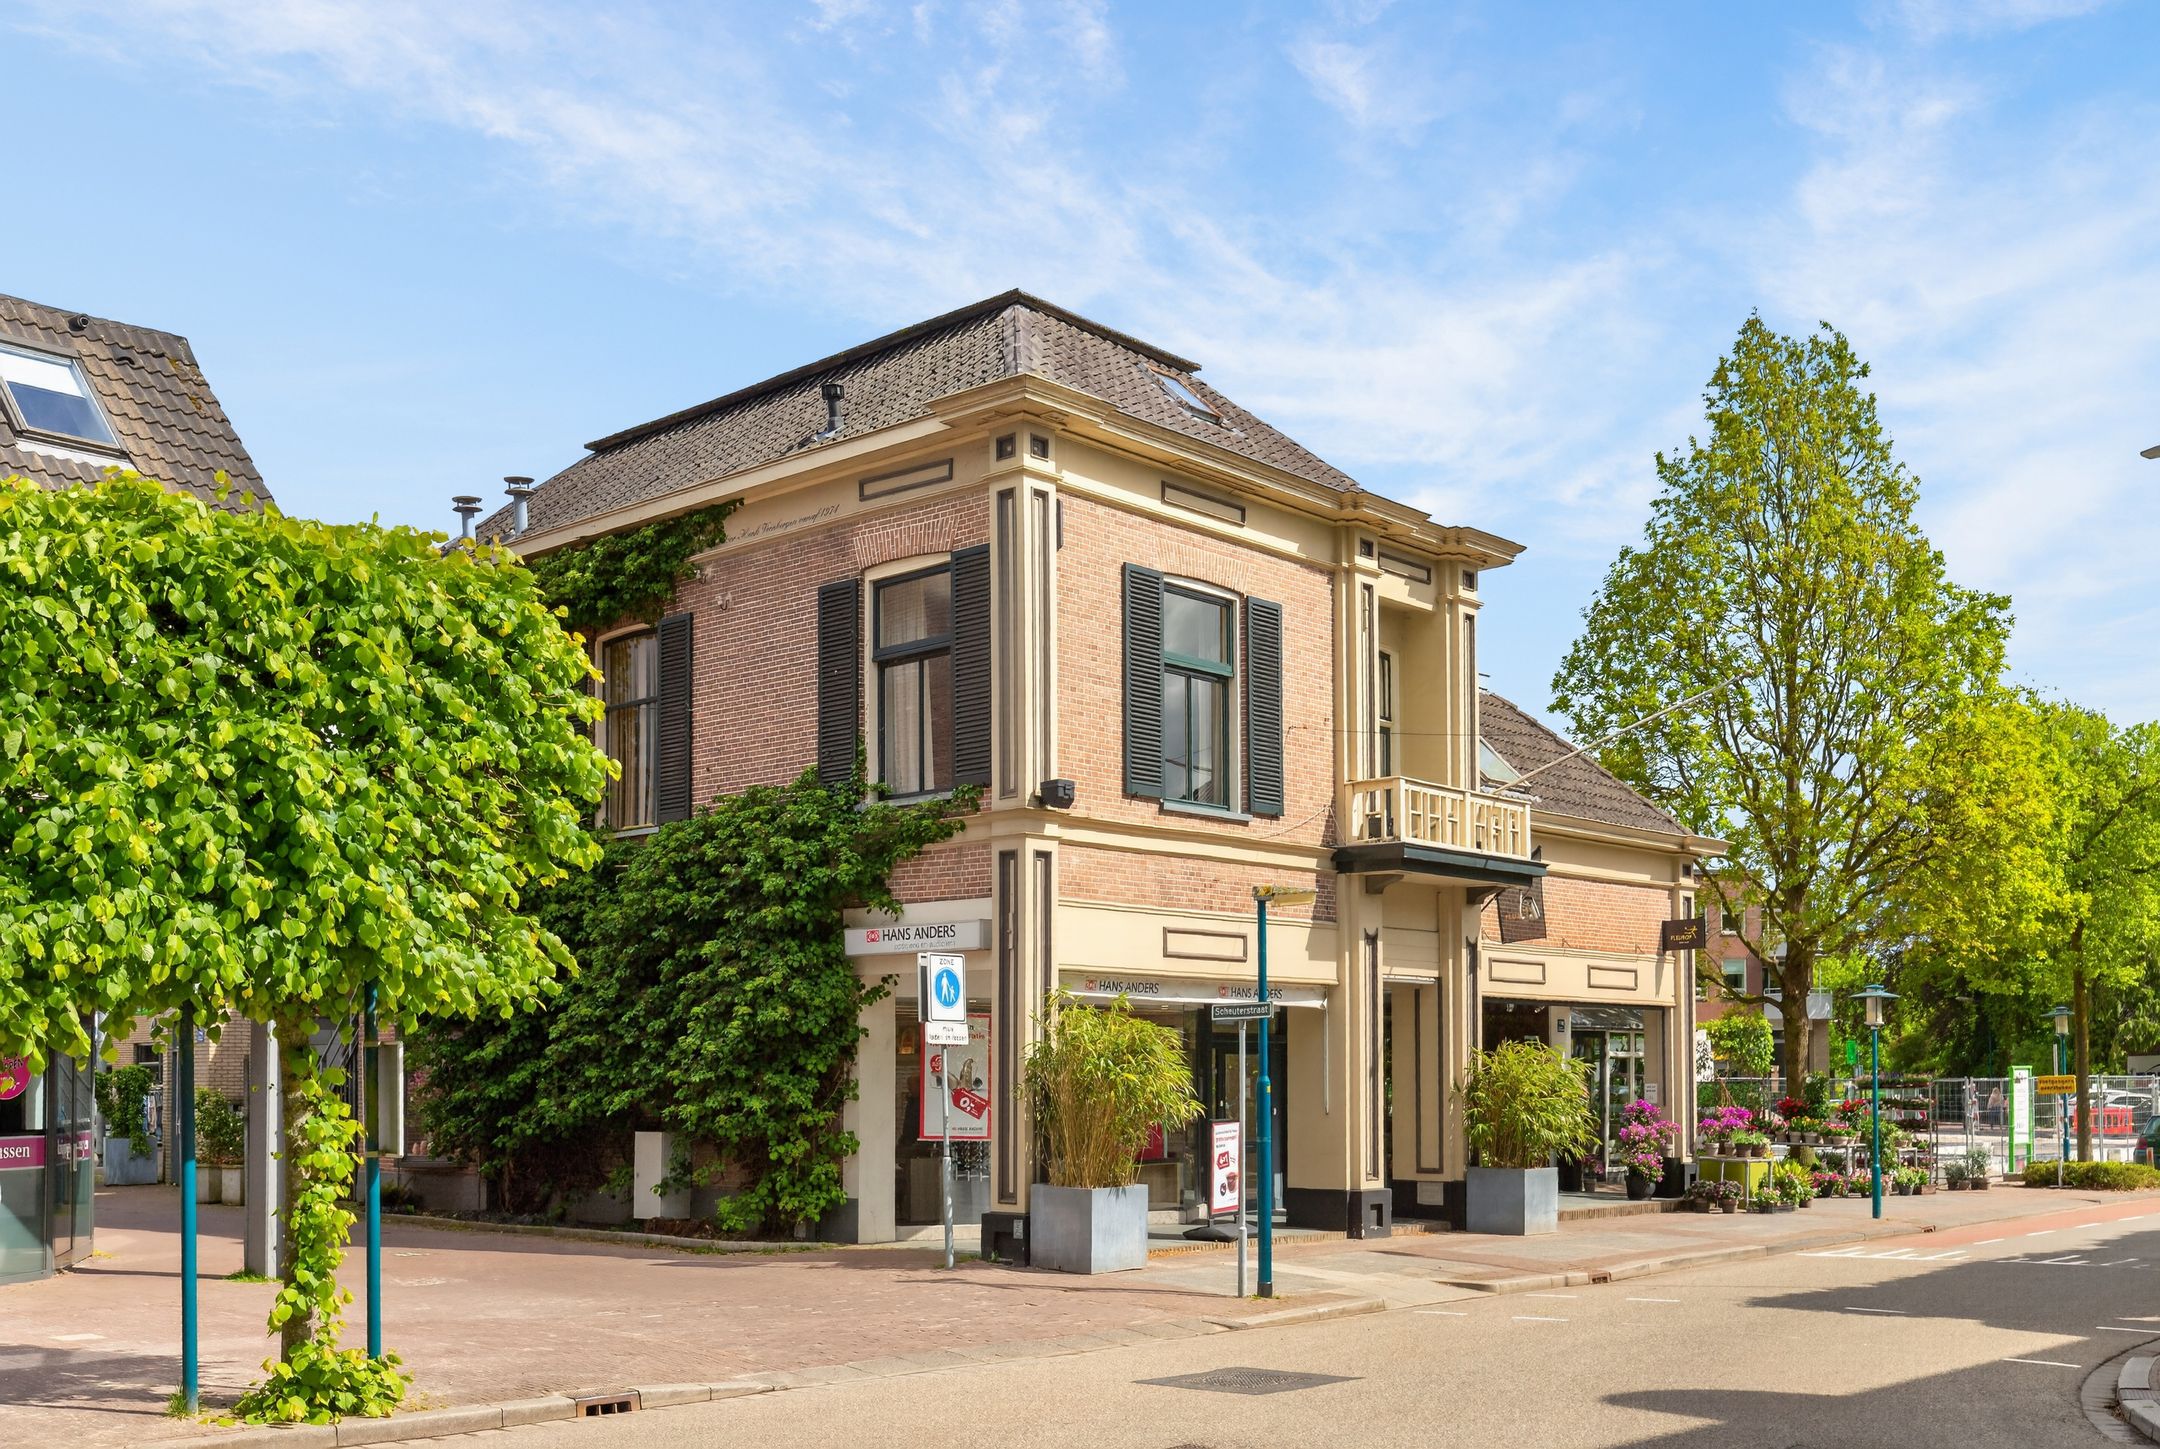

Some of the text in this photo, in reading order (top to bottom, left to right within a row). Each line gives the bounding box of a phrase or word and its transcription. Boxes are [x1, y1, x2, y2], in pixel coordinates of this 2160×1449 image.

[882, 925, 956, 941] HANS ANDERS
[939, 958, 955, 966] ZONE
[1099, 981, 1160, 994] HANS ANDERS
[1230, 985, 1283, 999] HANS ADERS
[1214, 1005, 1269, 1016] Scheuterstraat
